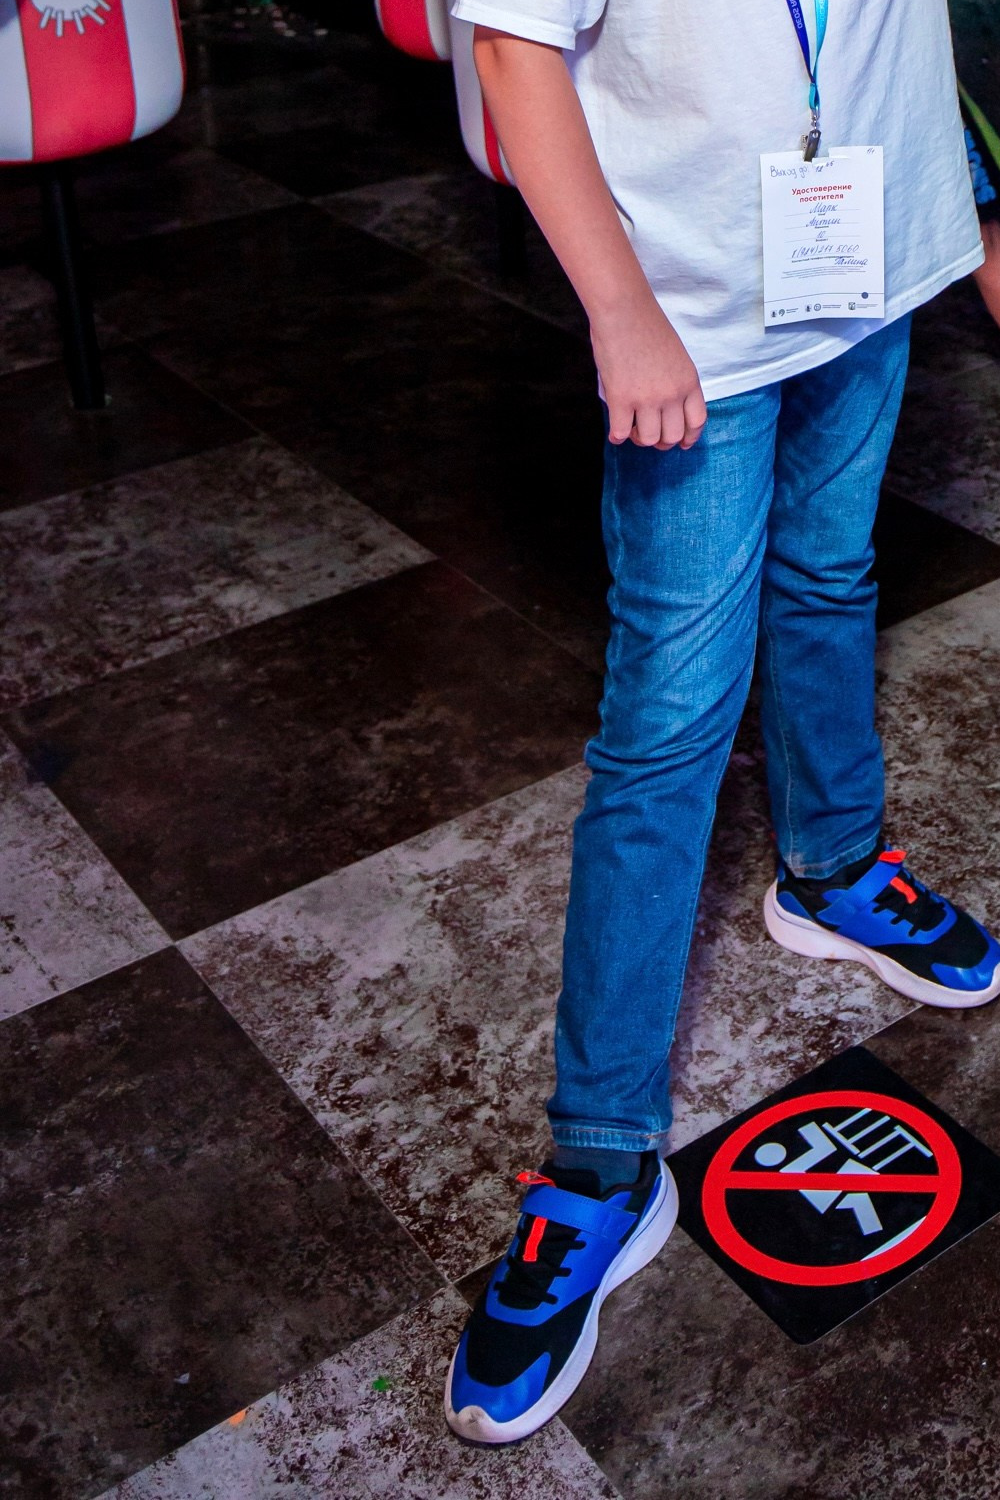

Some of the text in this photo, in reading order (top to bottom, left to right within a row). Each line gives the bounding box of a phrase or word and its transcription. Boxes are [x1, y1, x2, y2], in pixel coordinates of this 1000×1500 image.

[793, 8, 803, 29] 2030
[770, 165, 797, 179] Выход
[791, 184, 852, 196] Удостоверение
[800, 194, 844, 203] посетителя
